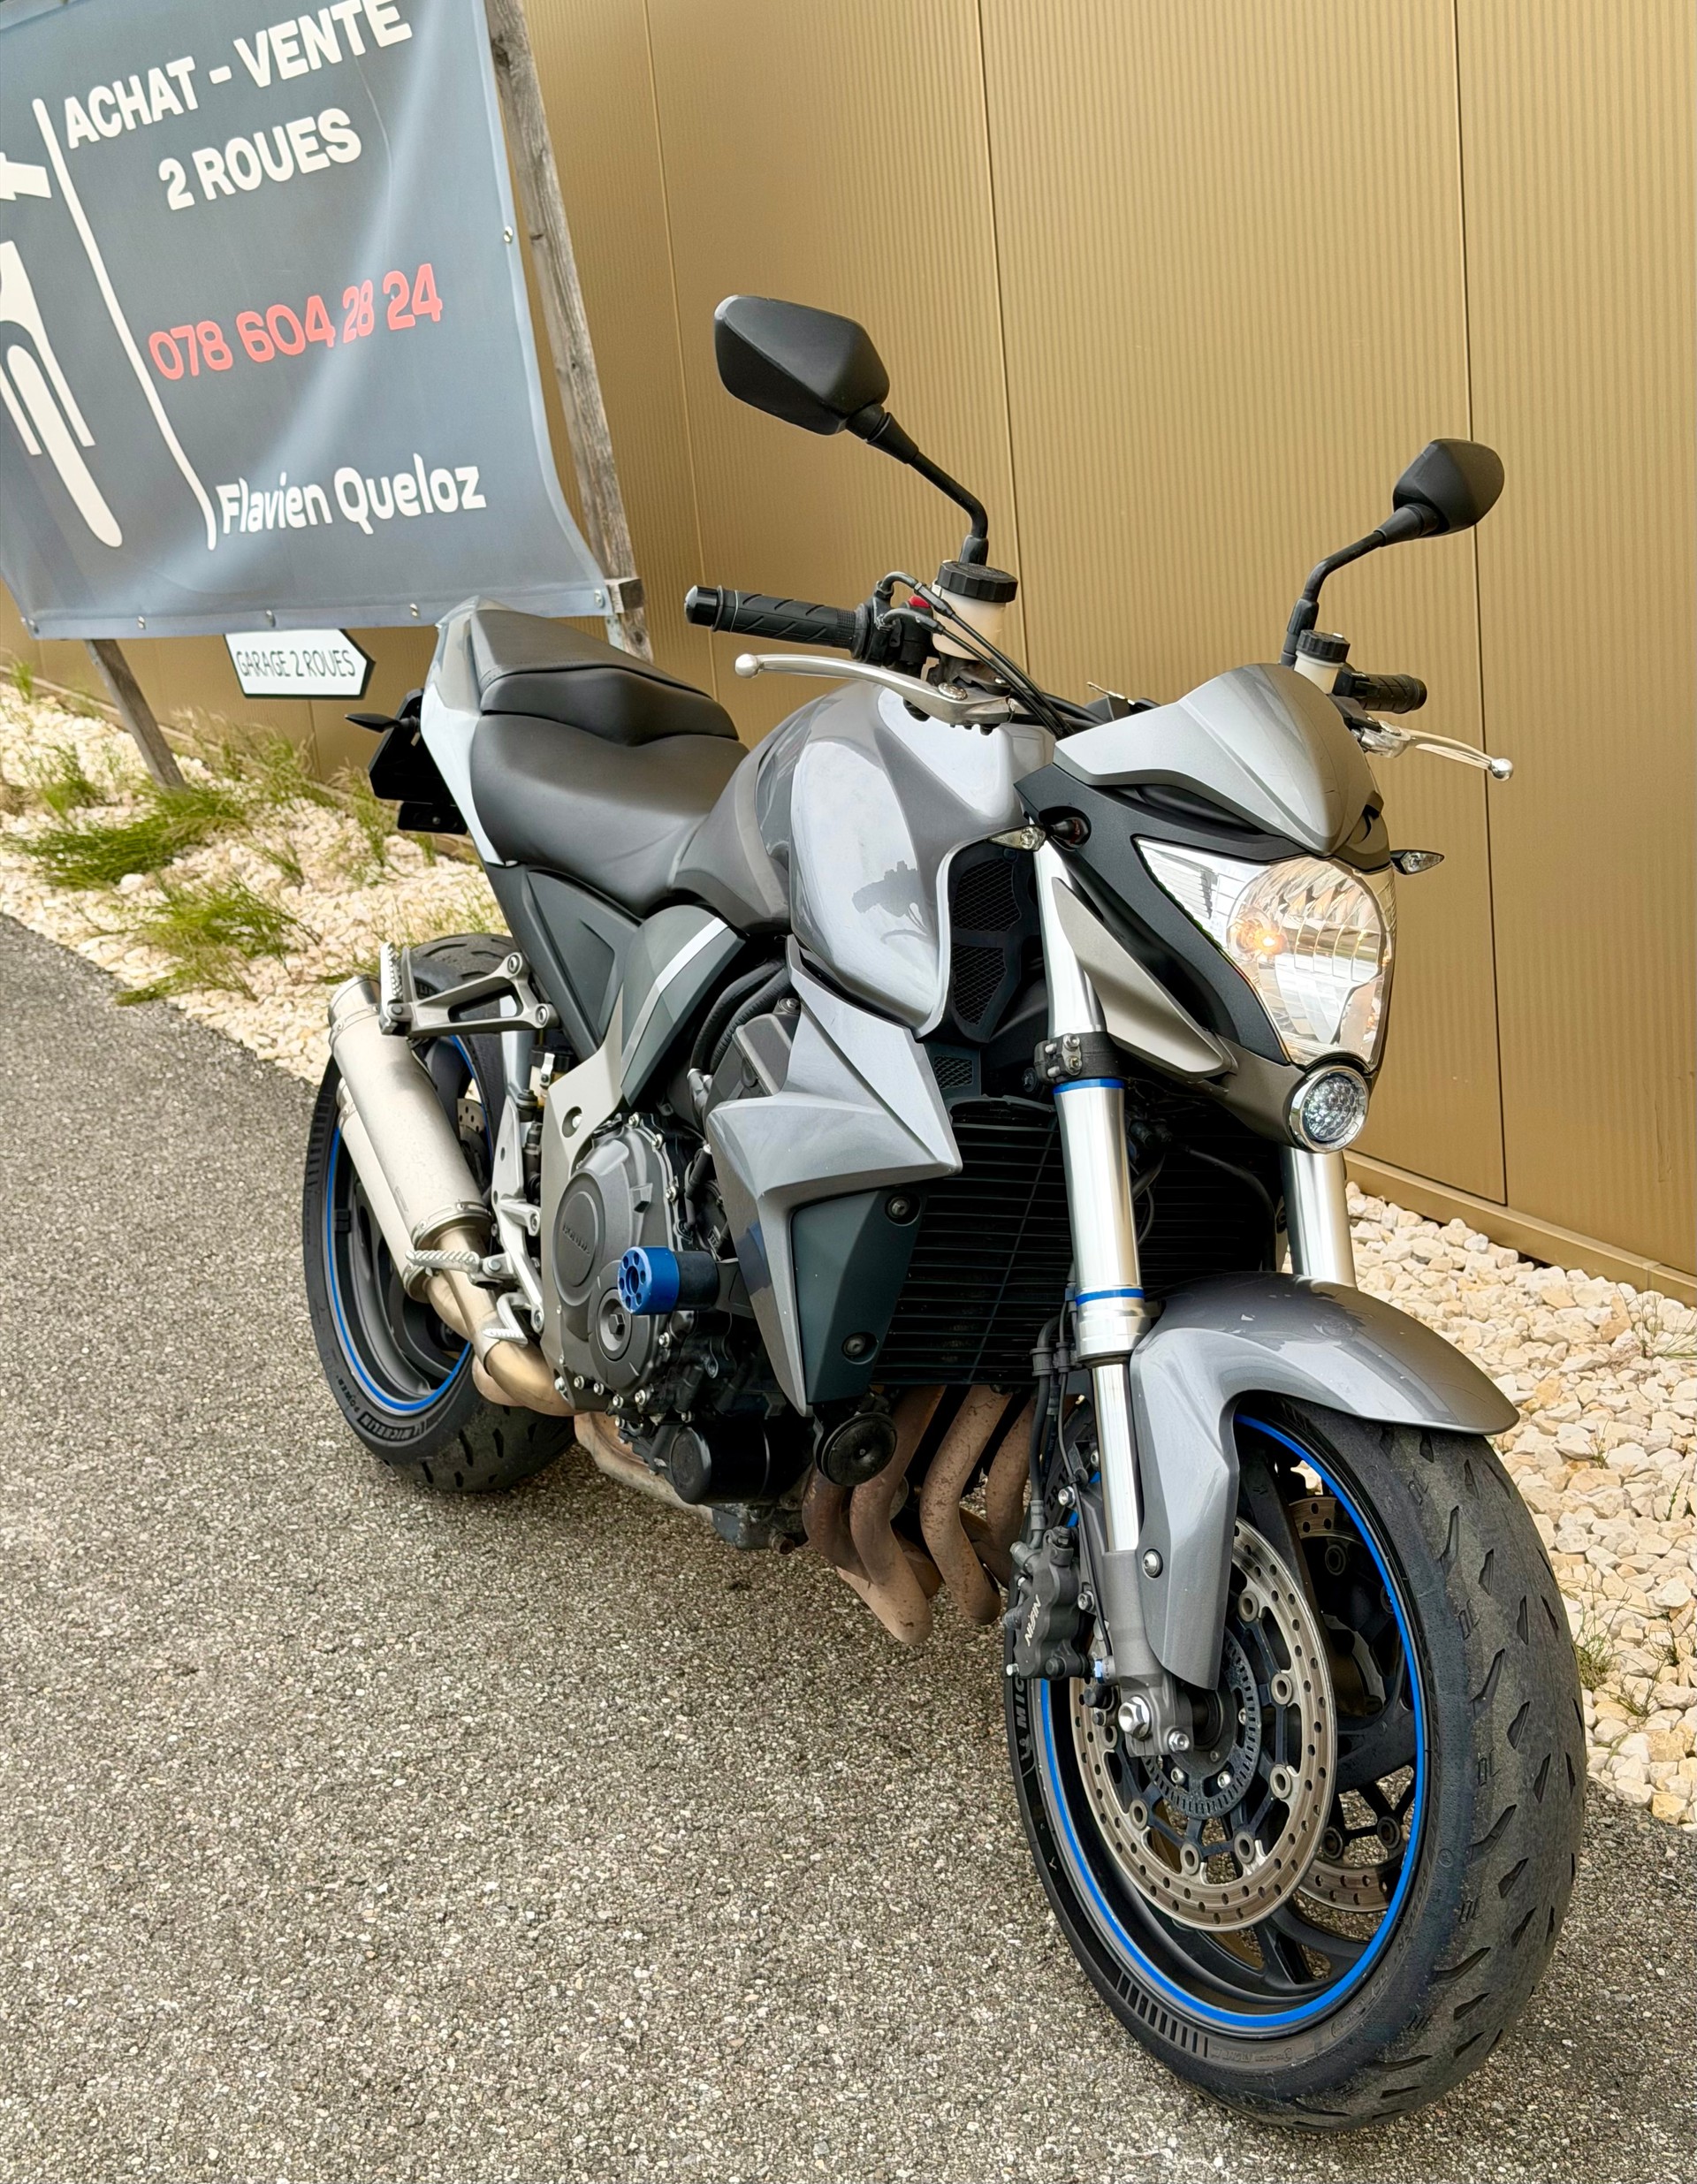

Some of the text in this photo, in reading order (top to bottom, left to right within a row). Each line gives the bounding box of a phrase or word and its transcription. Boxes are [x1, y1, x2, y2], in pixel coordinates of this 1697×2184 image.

[65, 56, 199, 149] ACHAT
[233, 0, 413, 88] VENTE
[158, 108, 362, 210] 2 ROUES
[148, 263, 443, 380] 078 604 28 24
[216, 453, 487, 535] Flavien Queloz
[236, 650, 355, 677] GARAGE 2 ROUES
